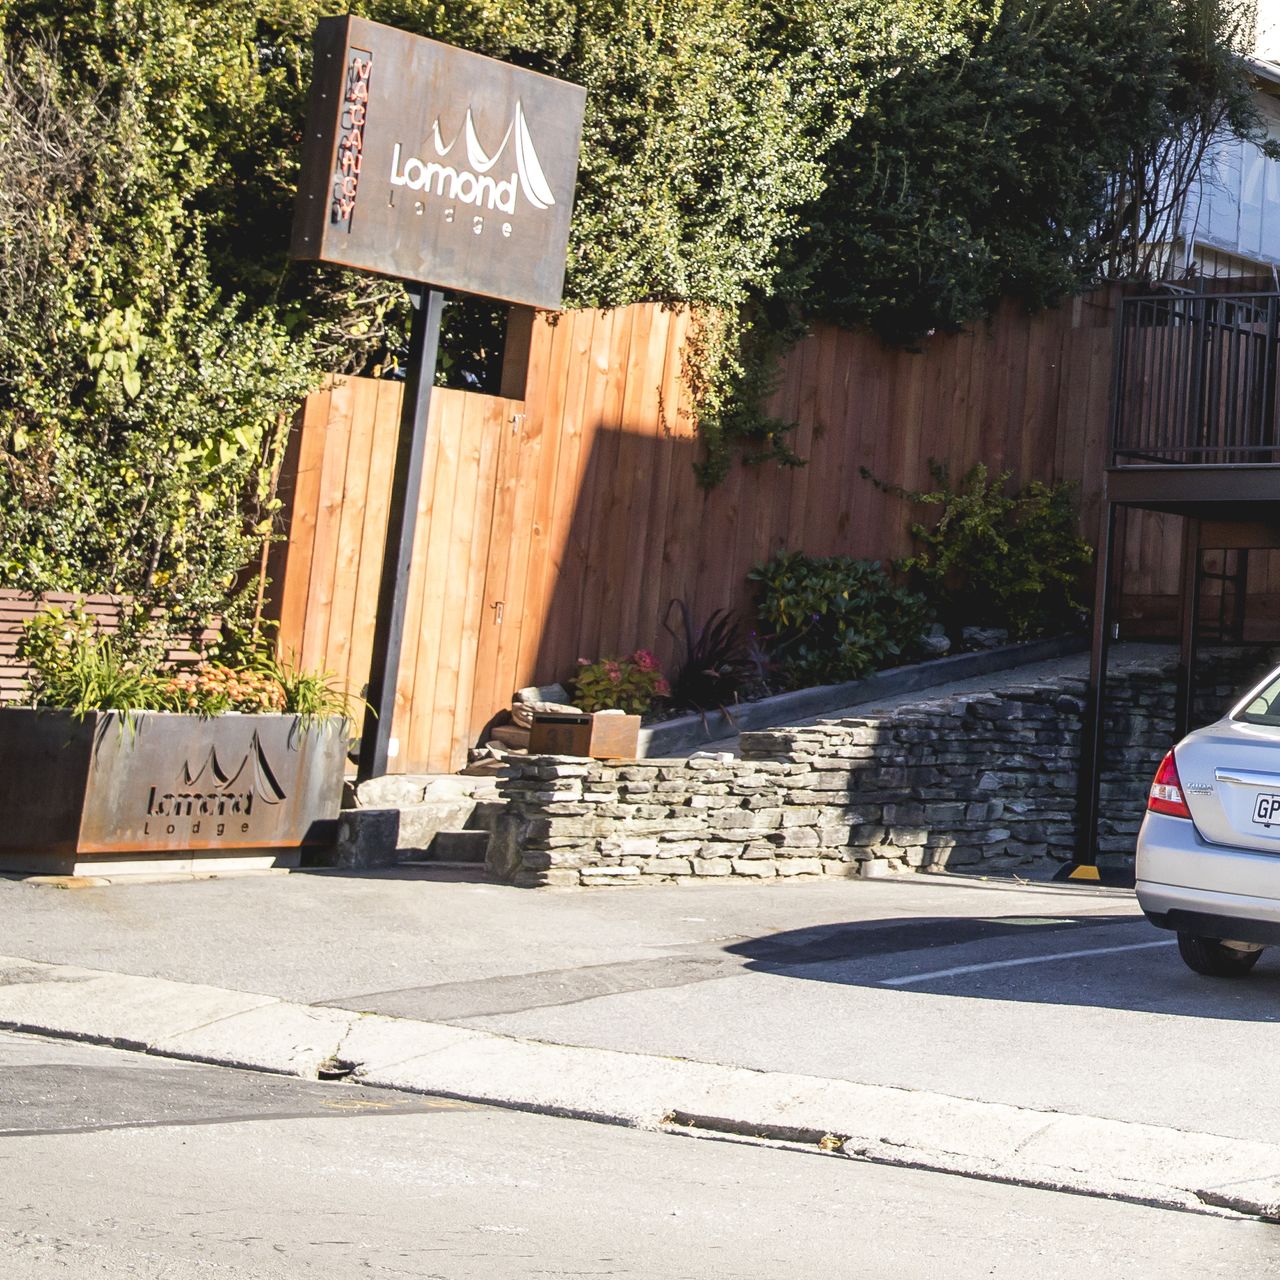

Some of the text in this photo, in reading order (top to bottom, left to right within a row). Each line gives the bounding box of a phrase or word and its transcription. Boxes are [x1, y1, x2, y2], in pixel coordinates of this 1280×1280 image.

[339, 57, 373, 220] VACANCY
[390, 142, 518, 215] Lomond
[144, 821, 249, 837] Lodge
